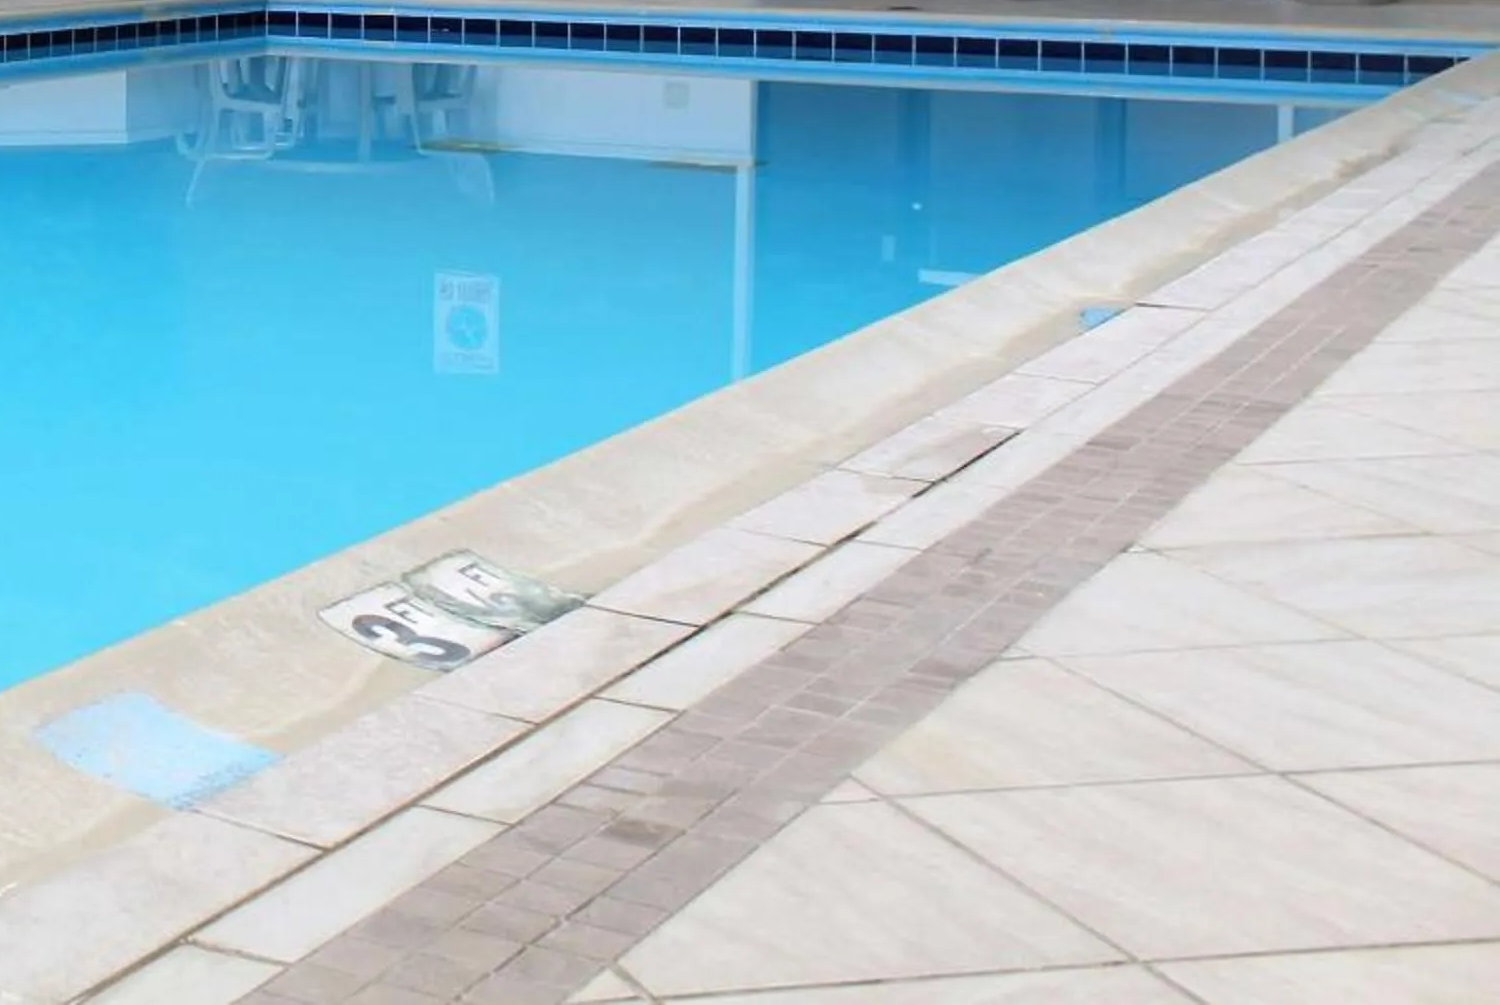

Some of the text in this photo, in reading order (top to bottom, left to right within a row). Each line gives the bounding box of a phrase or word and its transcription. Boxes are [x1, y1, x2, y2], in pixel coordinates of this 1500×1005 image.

[457, 561, 501, 587] FT
[384, 596, 435, 624] FT
[352, 614, 471, 662] 3
